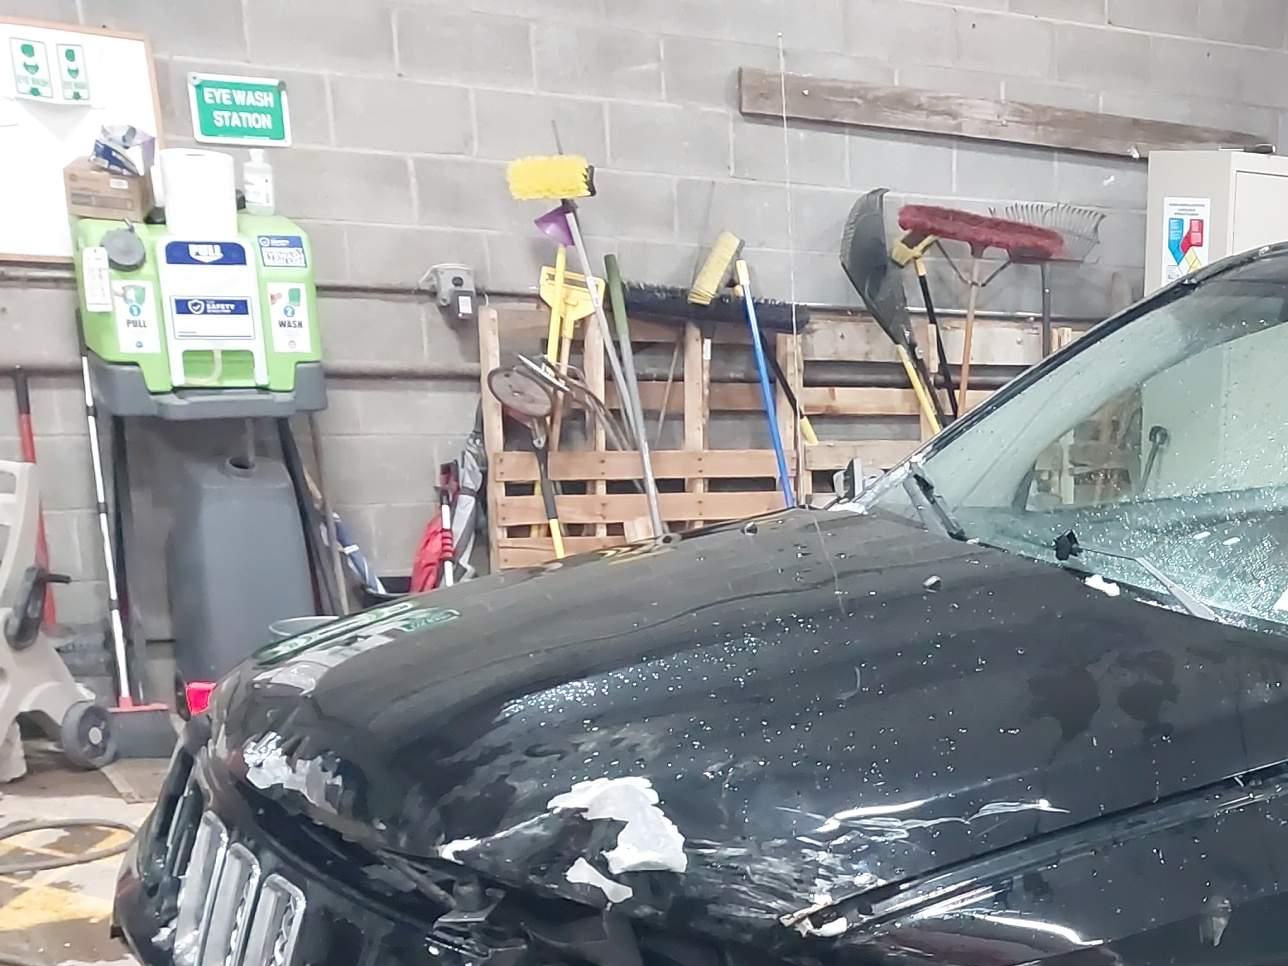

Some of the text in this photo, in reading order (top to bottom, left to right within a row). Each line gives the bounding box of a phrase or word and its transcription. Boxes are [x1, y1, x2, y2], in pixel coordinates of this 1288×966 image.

[203, 87, 274, 108] EYE WASH
[212, 110, 273, 129] STATION
[126, 319, 148, 329] PULL
[278, 320, 303, 329] WASH
